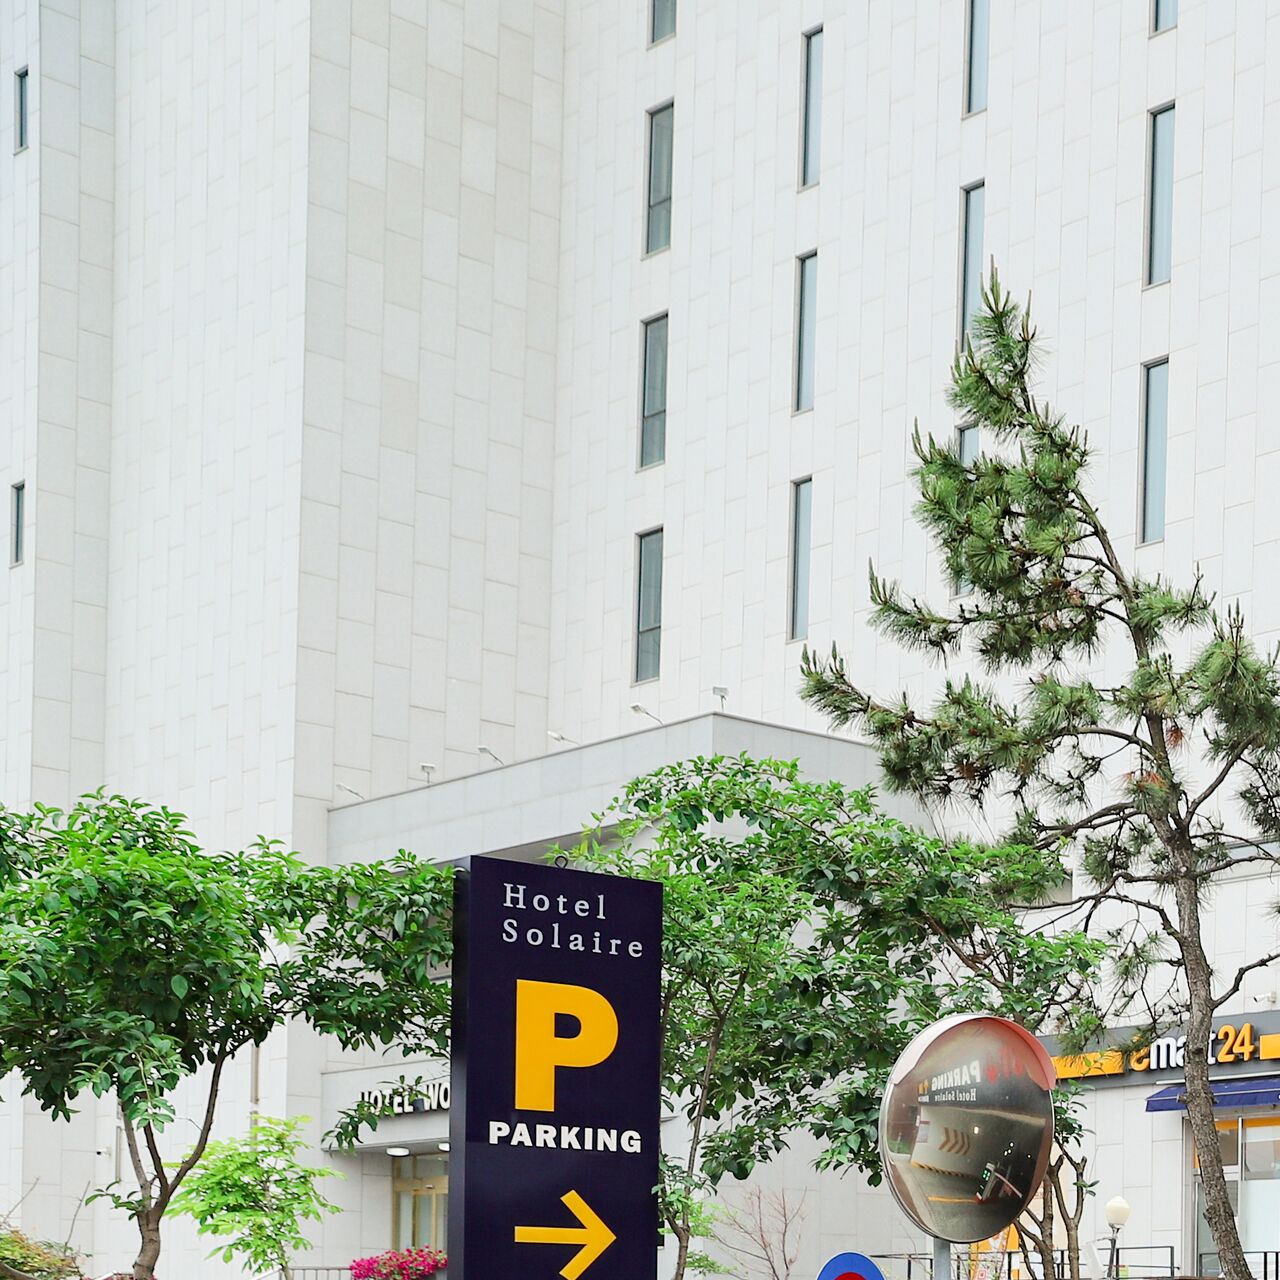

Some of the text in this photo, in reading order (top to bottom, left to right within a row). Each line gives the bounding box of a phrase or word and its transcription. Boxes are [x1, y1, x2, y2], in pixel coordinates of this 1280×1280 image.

[502, 883, 607, 920] Hotel
[501, 918, 644, 958] Solaire
[514, 979, 619, 1112] P
[488, 1120, 642, 1154] PARKING
